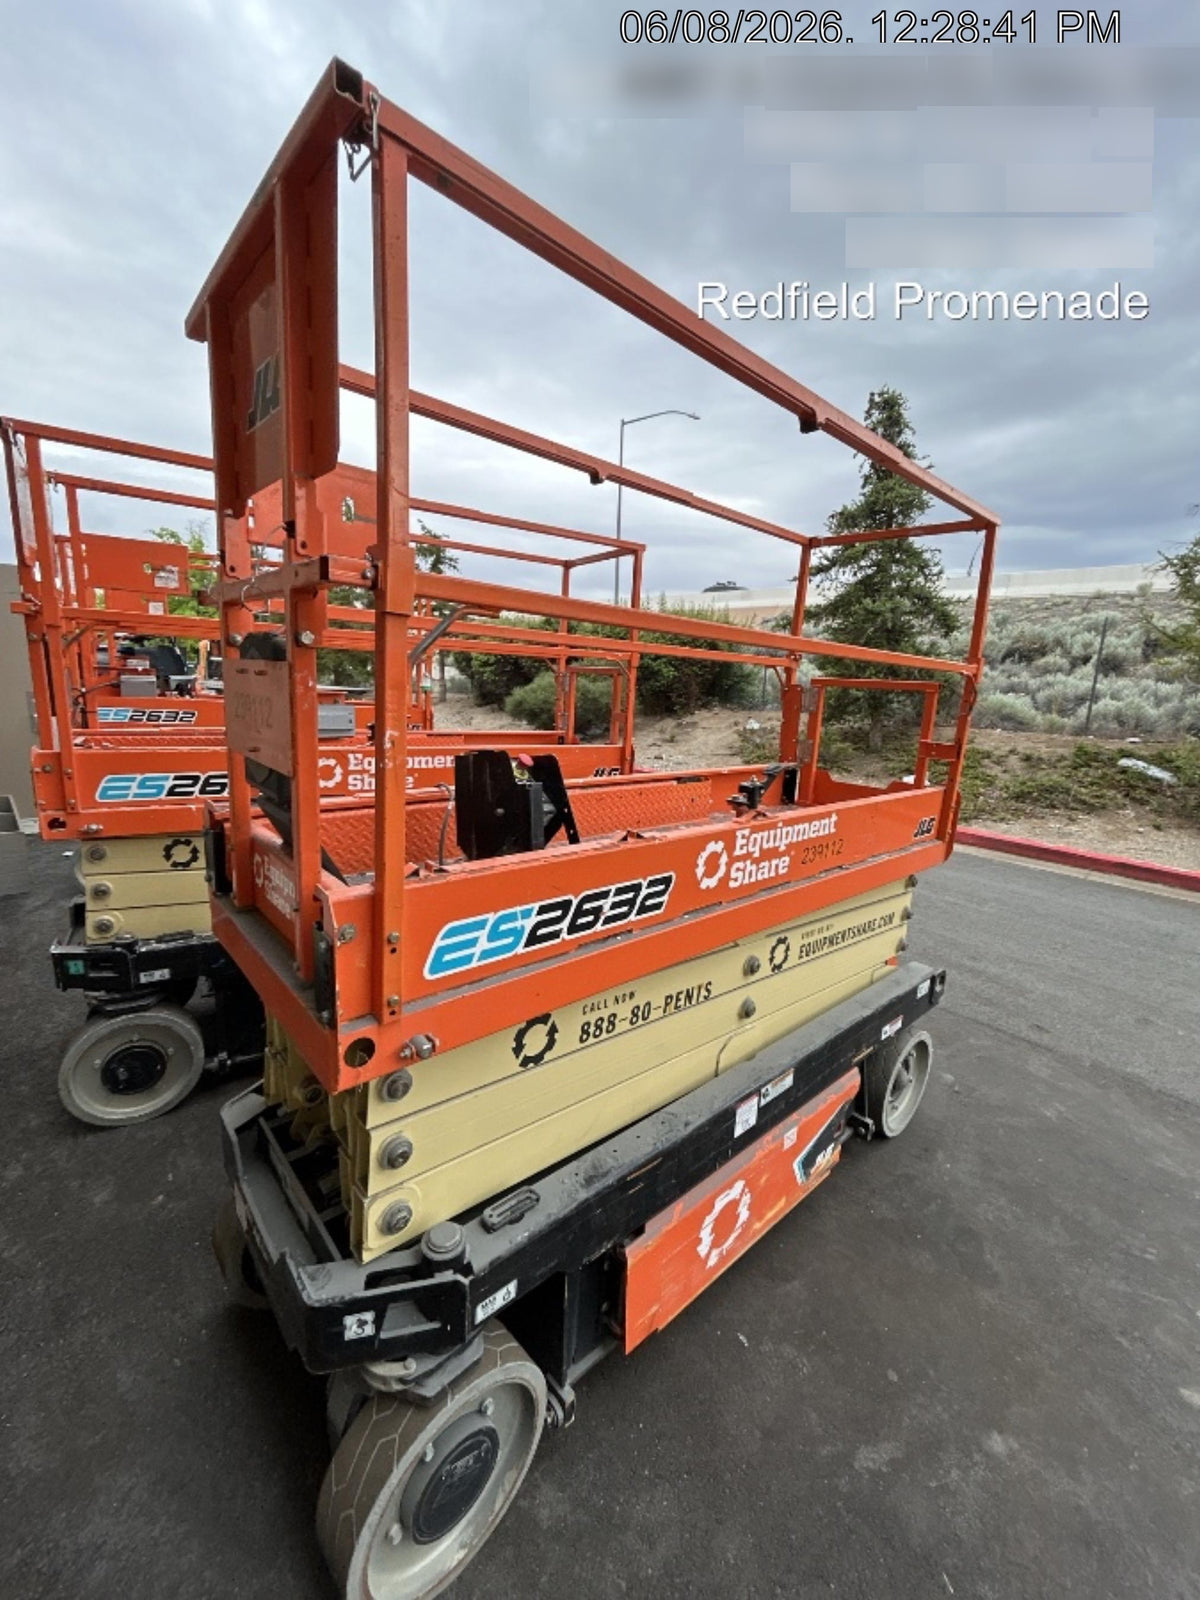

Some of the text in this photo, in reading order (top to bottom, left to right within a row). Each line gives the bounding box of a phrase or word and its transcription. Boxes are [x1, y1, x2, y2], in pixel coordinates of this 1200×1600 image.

[97, 706, 197, 724] ES2632
[94, 771, 229, 802] ES26
[734, 812, 838, 857] Equipment
[728, 855, 790, 888] Share
[423, 871, 676, 980] ES2632
[582, 998, 608, 1016] CALL
